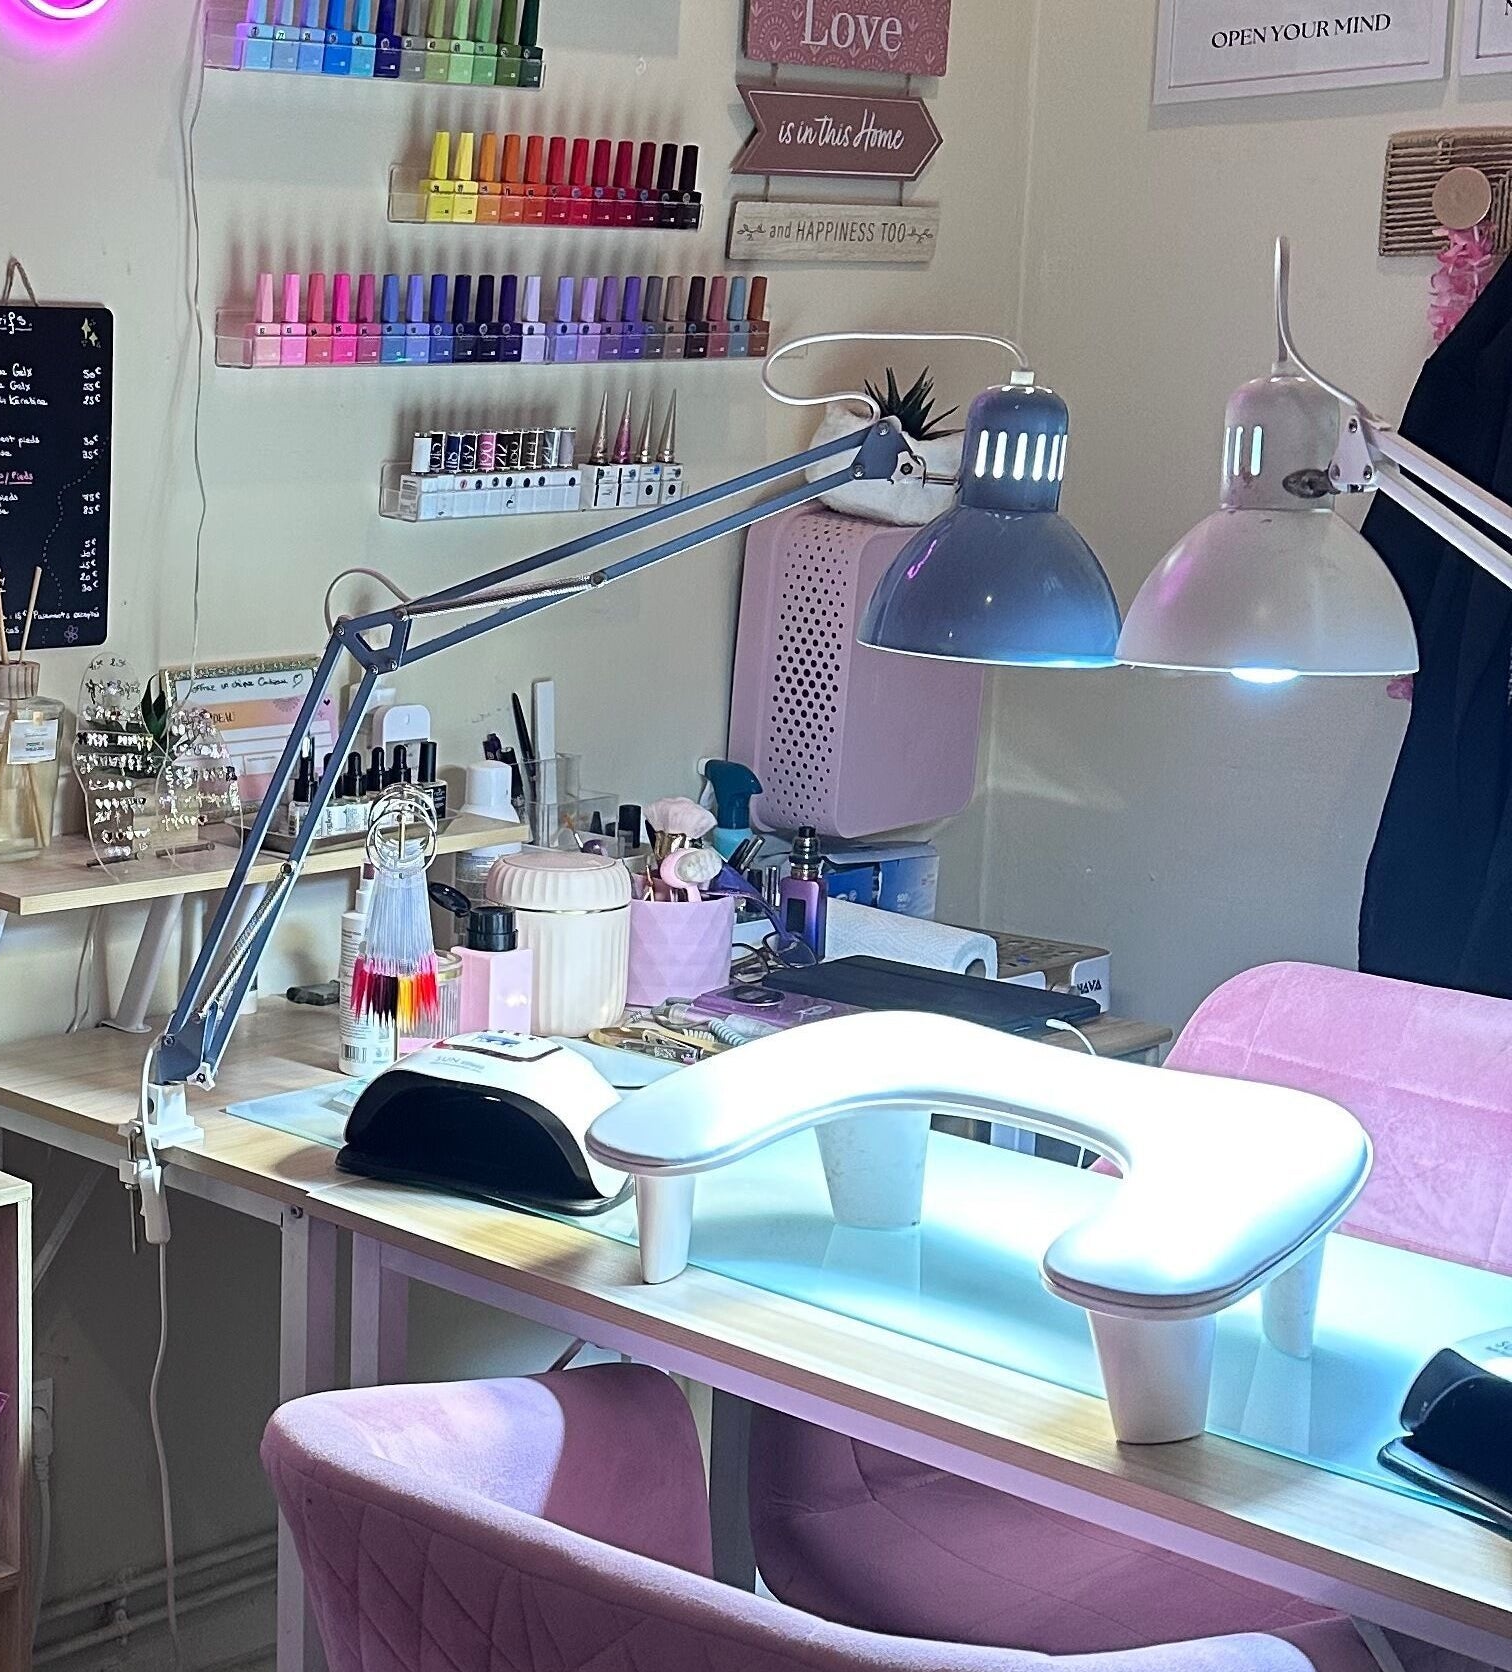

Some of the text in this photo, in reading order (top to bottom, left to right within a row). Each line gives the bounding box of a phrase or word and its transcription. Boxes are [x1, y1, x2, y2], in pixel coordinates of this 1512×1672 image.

[801, 0, 903, 52] Love
[1211, 13, 1392, 49] OPEN YOUR MIND
[778, 120, 795, 144] is
[797, 119, 817, 146] in
[852, 108, 905, 152] Home
[769, 221, 906, 243] and HAPPINESS TOO
[18, 435, 40, 448] pieds
